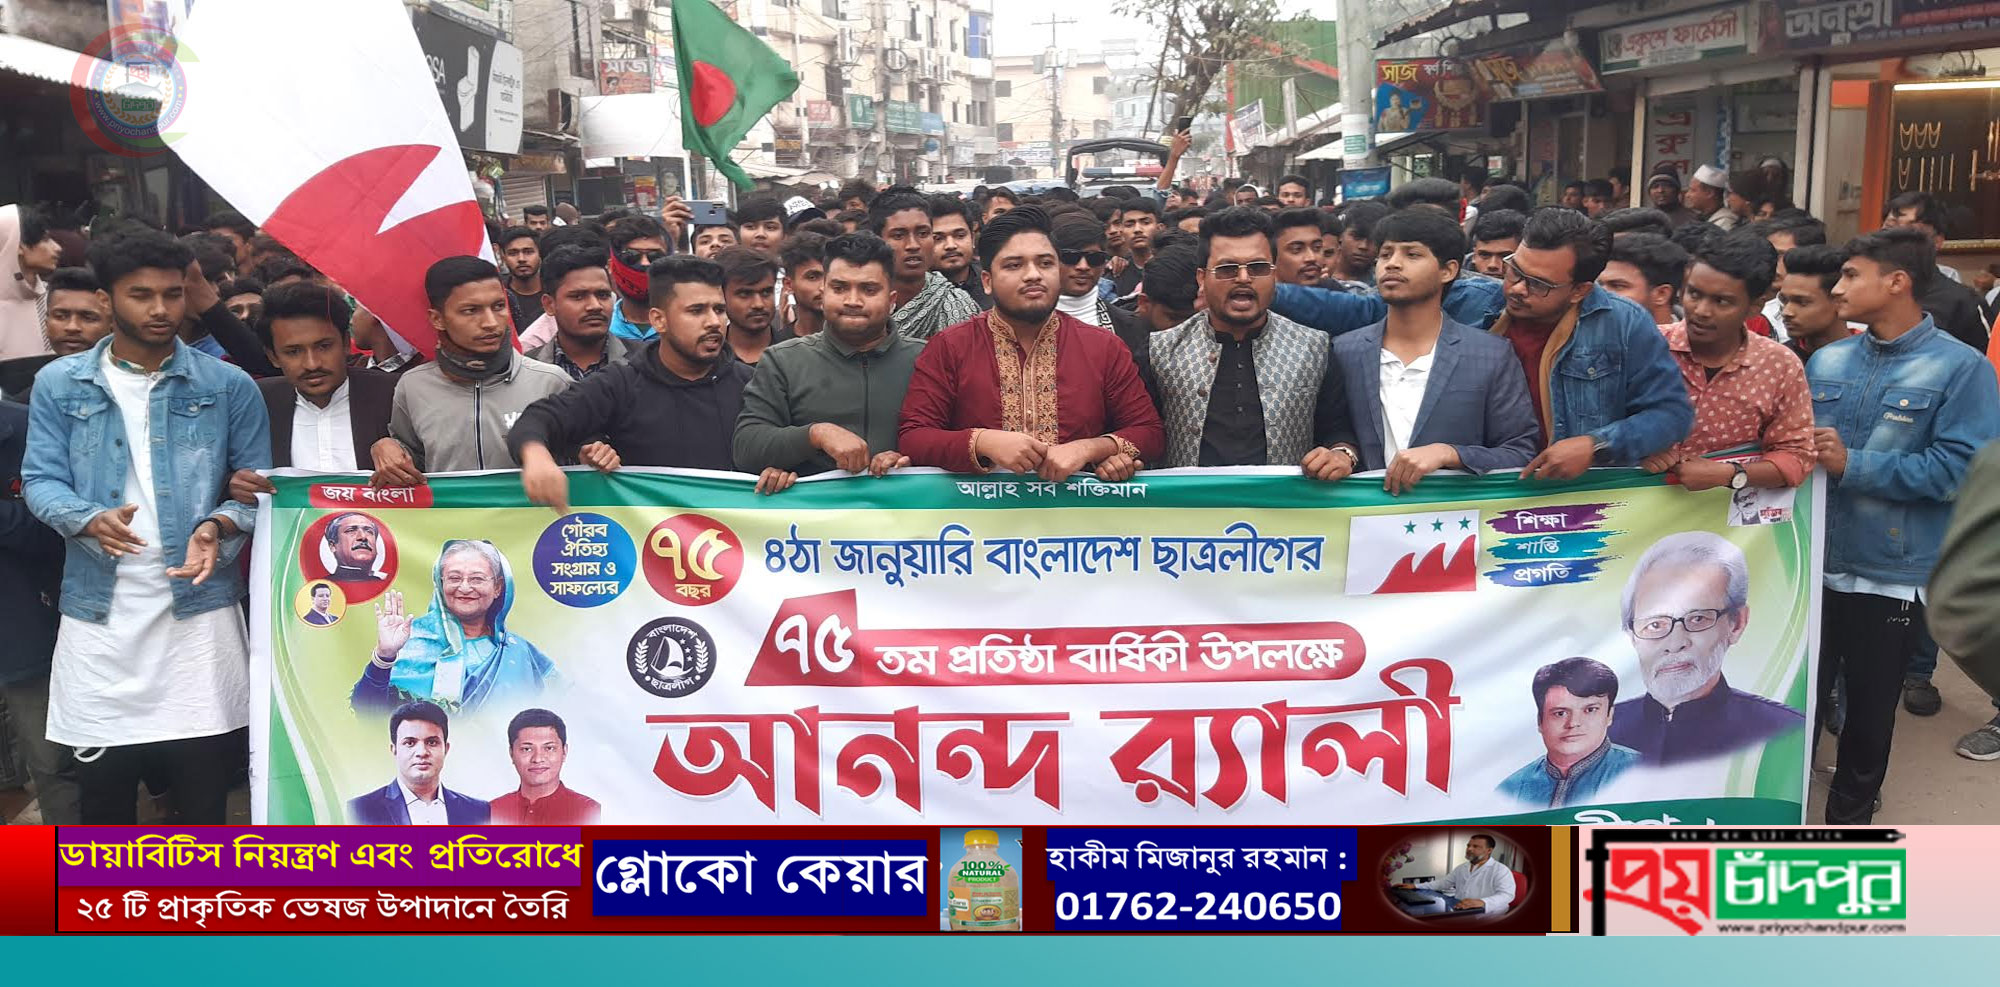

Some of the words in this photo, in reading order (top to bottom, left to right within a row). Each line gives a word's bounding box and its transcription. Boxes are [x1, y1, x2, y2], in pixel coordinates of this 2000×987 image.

[1382, 63, 1418, 84] সাজ
[321, 485, 357, 502] জয়
[362, 486, 415, 503] বাংলা
[956, 481, 1020, 499] আল্লাহ
[1066, 477, 1148, 499] শক্তিমান
[561, 516, 608, 537] গৌরব
[1514, 511, 1569, 530] শিক্ষা
[561, 537, 608, 557] ঐতিহ্য
[651, 528, 733, 580] ৭৫
[1516, 536, 1561, 554] শান্তি
[765, 524, 822, 574] ৪ঠা
[831, 525, 975, 588] জানুয়ারি
[984, 536, 1140, 580] বাংলাদেশ
[1151, 523, 1325, 580] ছাত্রলীগের
[551, 562, 600, 577] সংগ্রাম
[604, 564, 617, 576] ও
[1513, 563, 1573, 582] প্রগতি
[550, 581, 619, 595] সাফল্যের
[675, 584, 711, 598] বছর
[646, 624, 698, 639] বাংলাদেশ
[774, 611, 857, 674] ৭৫
[874, 645, 938, 676] তম
[947, 634, 1055, 676] প্রতিষ্ঠা
[1066, 630, 1190, 674] বার্ষিকী
[1199, 632, 1345, 672] উপলক্ষে
[651, 676, 696, 691] ছাত্রলীগ
[645, 704, 1070, 818] আনন্দ
